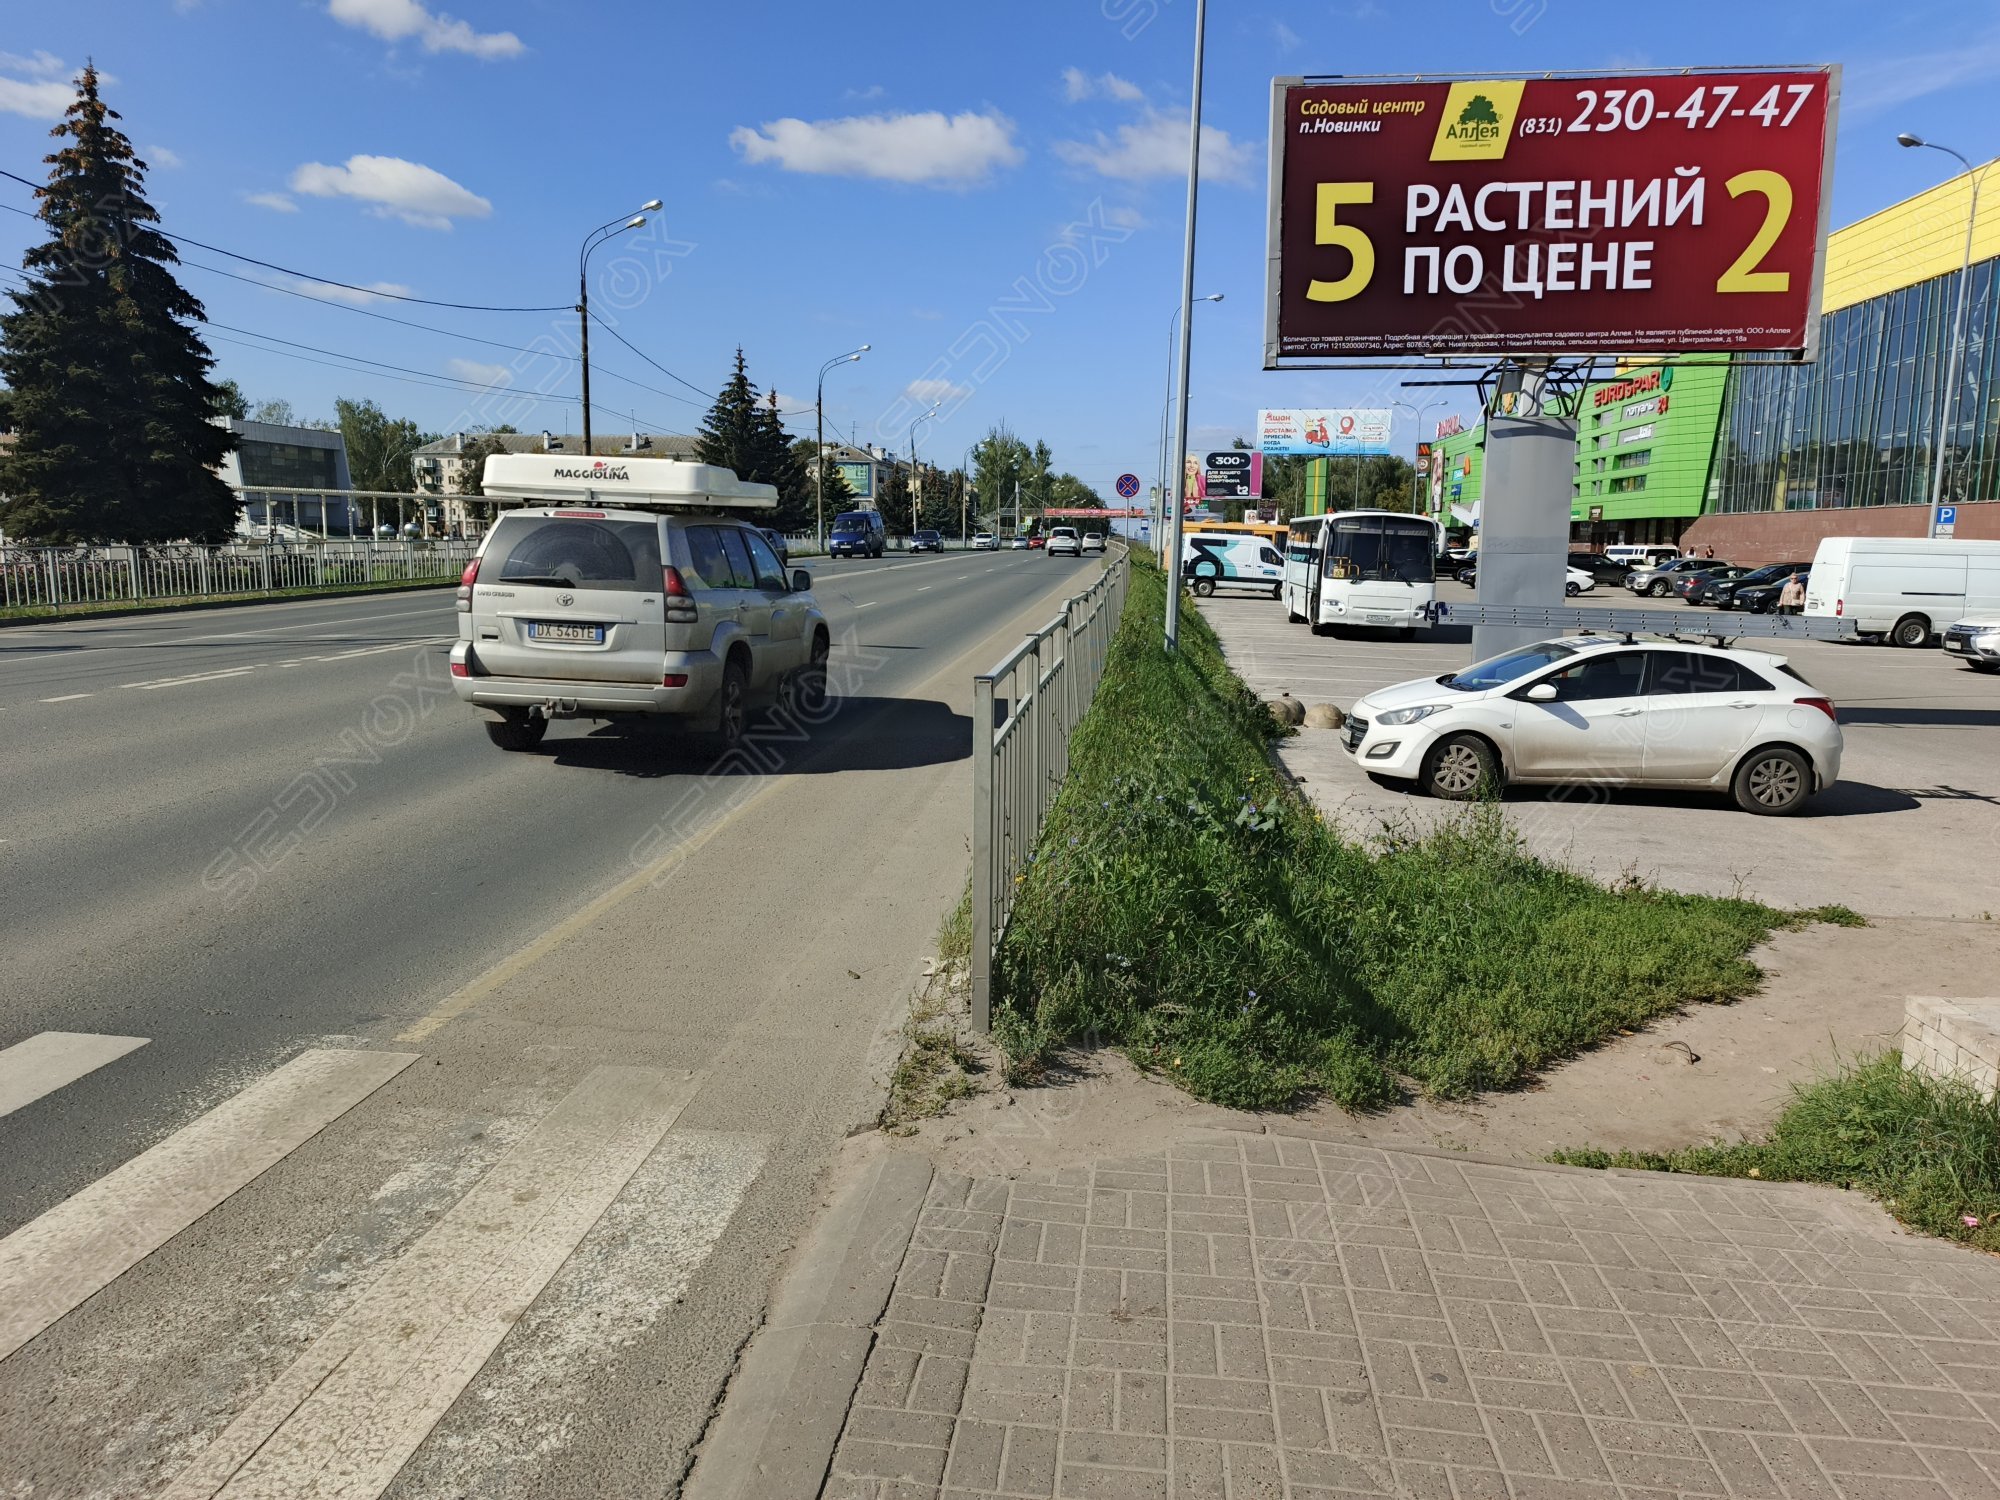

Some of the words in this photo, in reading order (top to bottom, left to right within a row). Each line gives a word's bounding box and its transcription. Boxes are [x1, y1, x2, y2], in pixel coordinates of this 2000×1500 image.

[1300, 99, 1367, 115] Садовый
[1372, 100, 1425, 116] центр
[1519, 117, 1562, 138] (831)
[1567, 84, 1814, 133] 230-47-47
[1299, 118, 1381, 134] п.Новинки
[1446, 124, 1499, 140] Аллея
[1406, 166, 1705, 232] РАСТЕНИЙ
[1306, 182, 1375, 302] 5
[1716, 170, 1793, 293] 2
[1403, 245, 1484, 294] ПО
[1503, 241, 1654, 299] ЦЕНЕ
[1677, 328, 1713, 336] публичной
[1714, 328, 1744, 336] офертой.
[1594, 370, 1661, 408] EUROSPAR
[1940, 509, 1952, 522] P
[537, 623, 551, 637] DX
